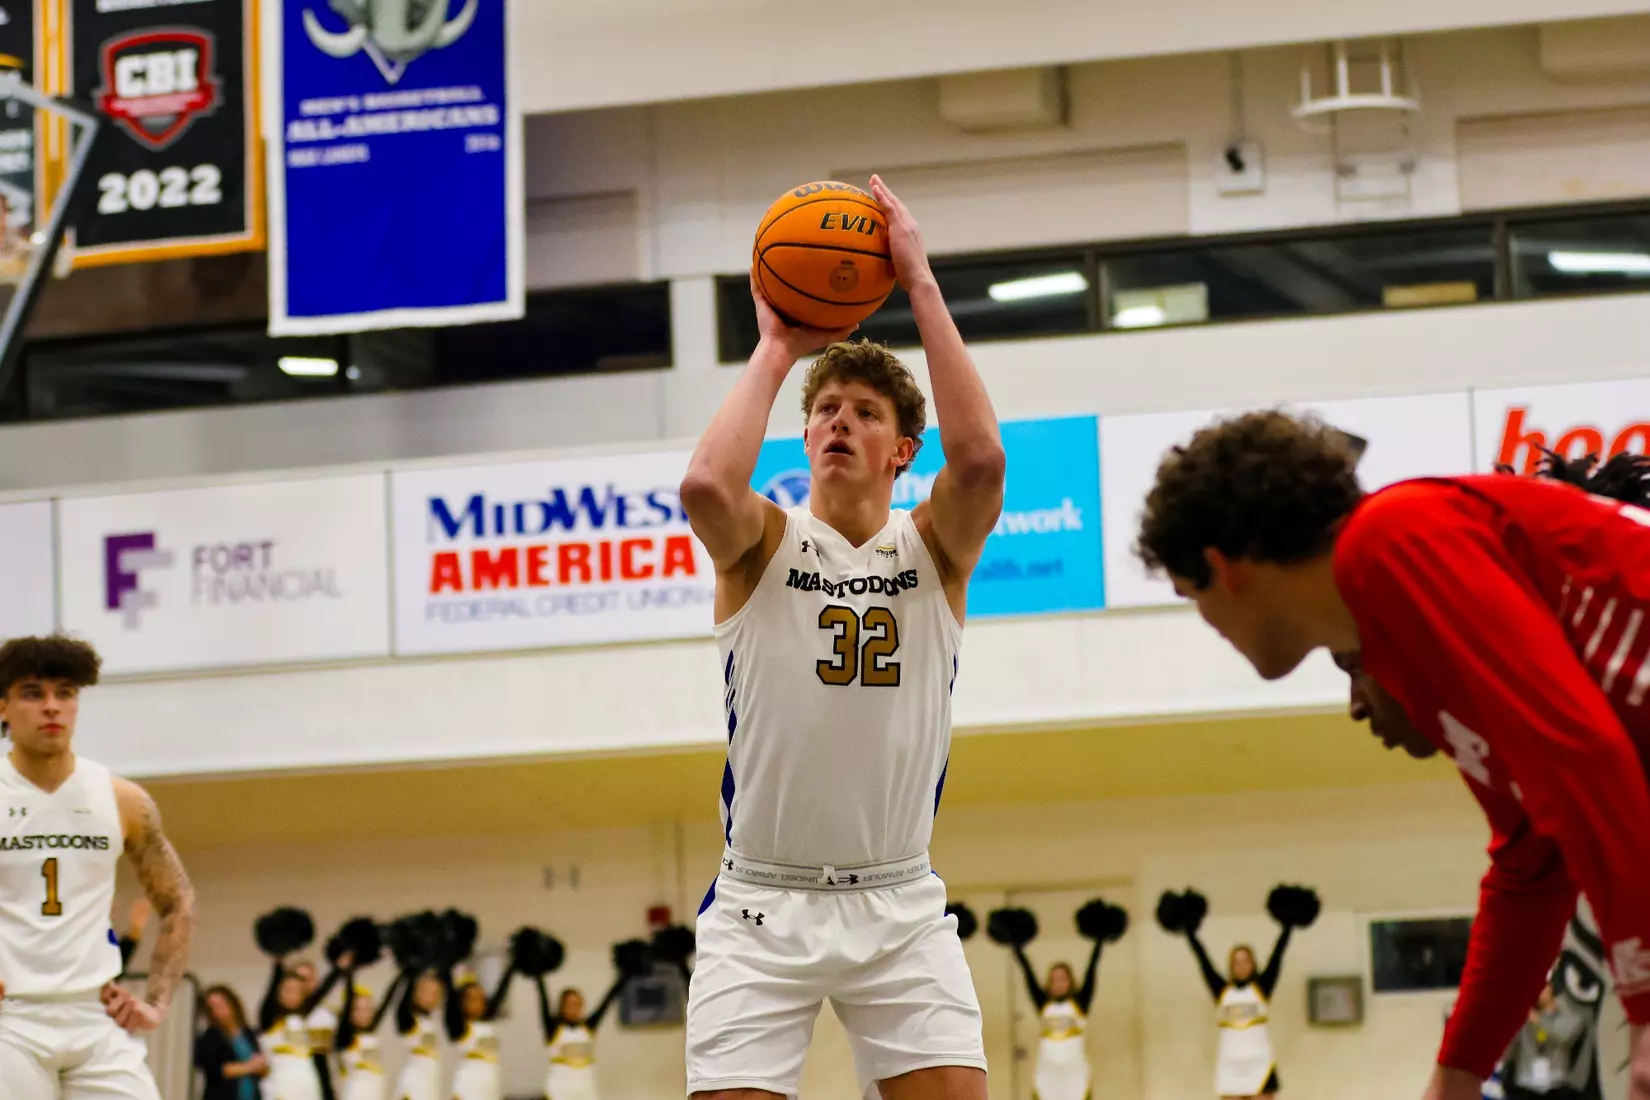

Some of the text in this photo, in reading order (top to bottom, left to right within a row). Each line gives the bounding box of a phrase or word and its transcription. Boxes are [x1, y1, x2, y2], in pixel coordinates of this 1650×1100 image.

[115, 49, 199, 97] CBI
[287, 104, 499, 142] ALL-AMERICANS
[97, 164, 222, 215] 2022
[192, 540, 274, 573] FORT
[430, 536, 697, 594] AMERICA
[191, 567, 344, 606] FINANCIAL
[785, 568, 919, 598] MASTODONS
[816, 604, 901, 687] 32
[41, 857, 62, 916] 1
